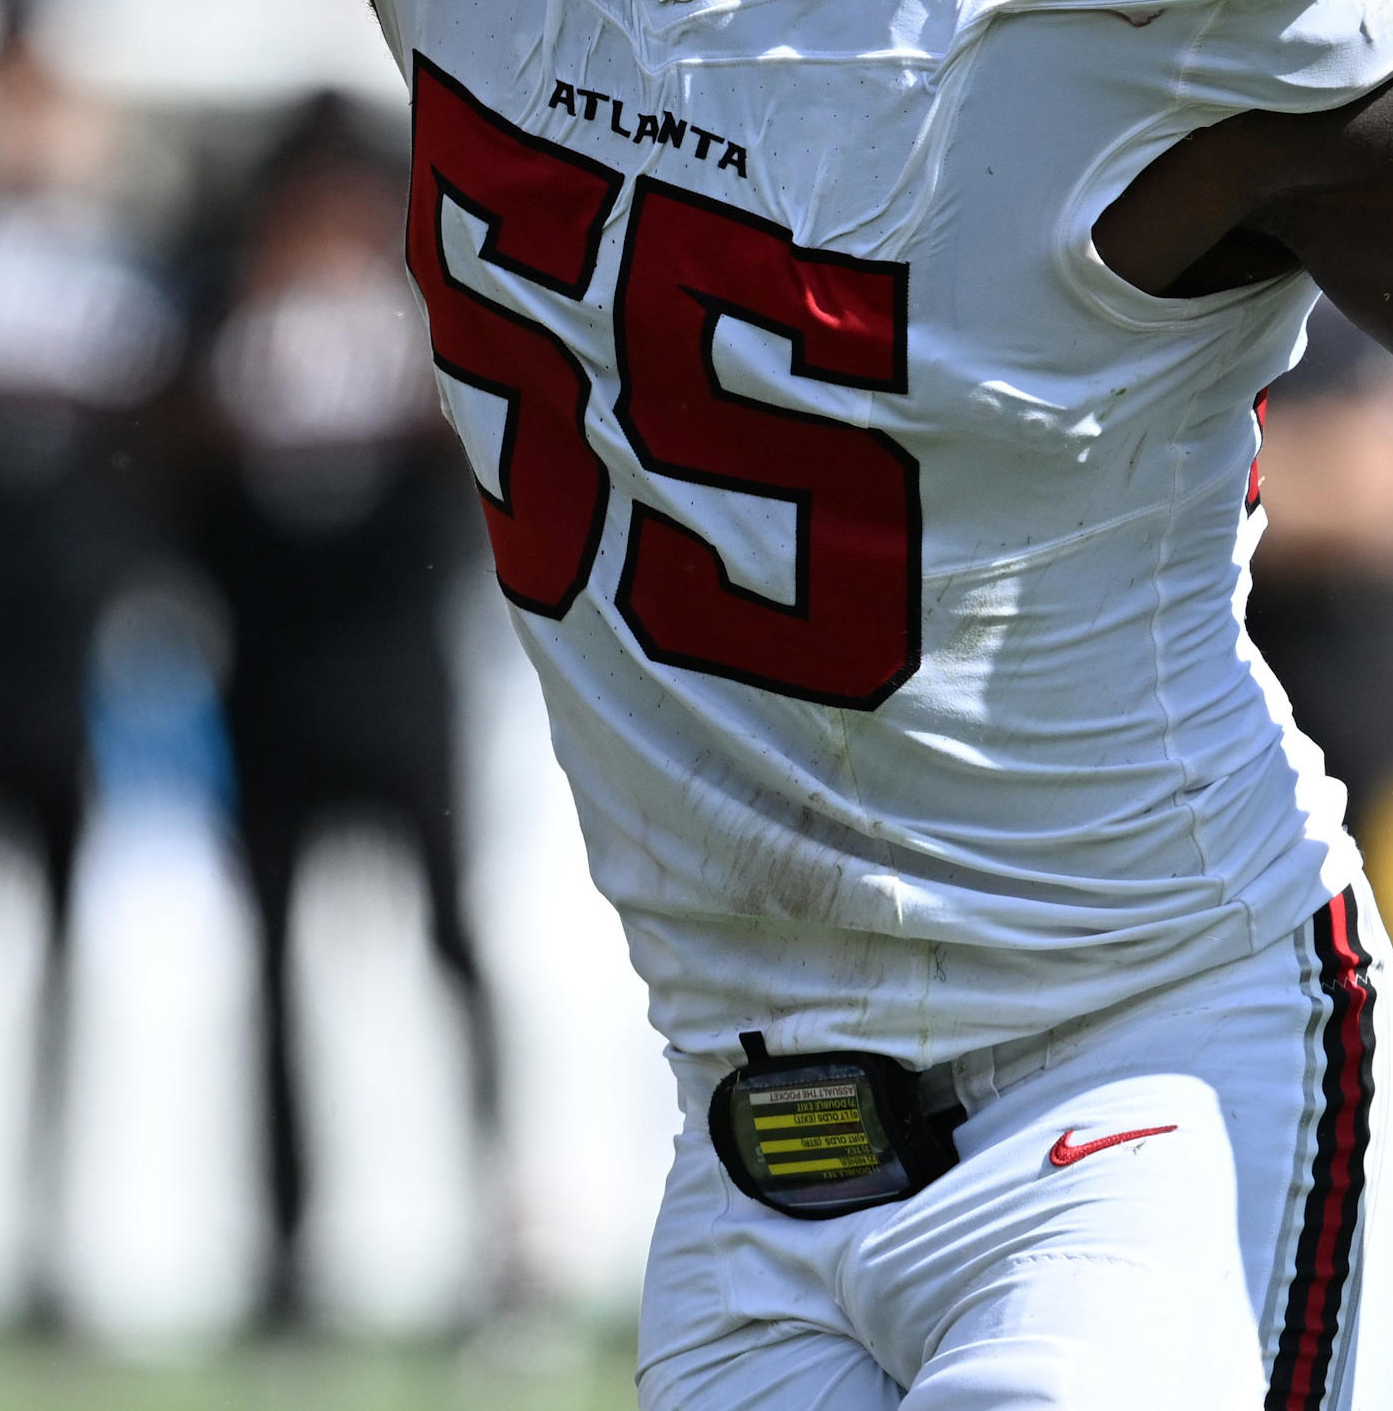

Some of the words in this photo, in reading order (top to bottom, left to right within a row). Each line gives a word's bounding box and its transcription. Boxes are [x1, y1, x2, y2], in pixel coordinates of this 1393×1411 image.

[548, 79, 748, 179] ATLANTA
[407, 48, 922, 713] 55
[769, 1091, 800, 1102] POCKET
[802, 1090, 818, 1099] THE
[819, 1087, 854, 1097] ASSUALT
[796, 1103, 813, 1112] EXIT
[814, 1100, 846, 1111] DOUBLE
[847, 1099, 855, 1107] 7)
[793, 1113, 816, 1124] (EXIT)
[817, 1113, 839, 1122] OLDS
[839, 1112, 849, 1120] LT
[825, 1137, 846, 1145] OLDS
